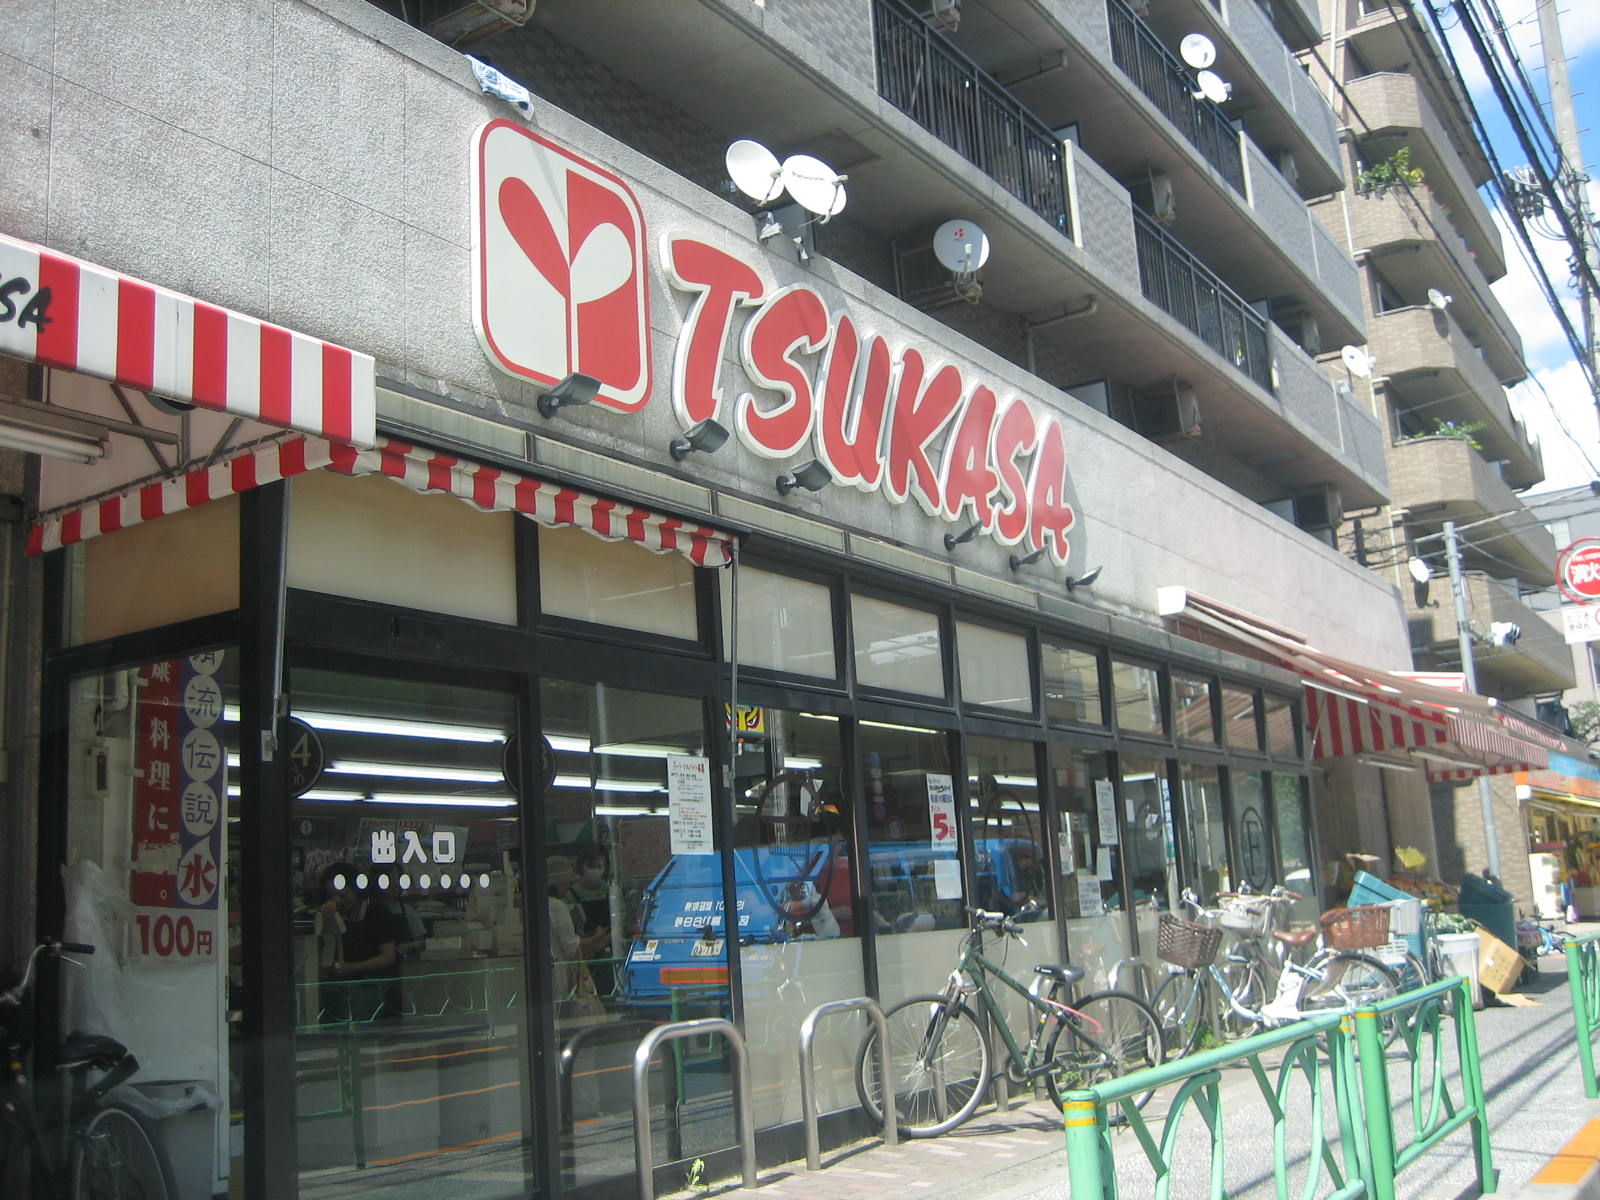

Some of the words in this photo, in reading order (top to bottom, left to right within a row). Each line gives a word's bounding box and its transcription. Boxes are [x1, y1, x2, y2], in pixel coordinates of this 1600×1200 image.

[0, 272, 53, 333] SA
[661, 232, 1074, 565] TSUKASA
[290, 732, 311, 767] 4
[371, 829, 456, 864] 出入口
[136, 915, 212, 957] 100円
